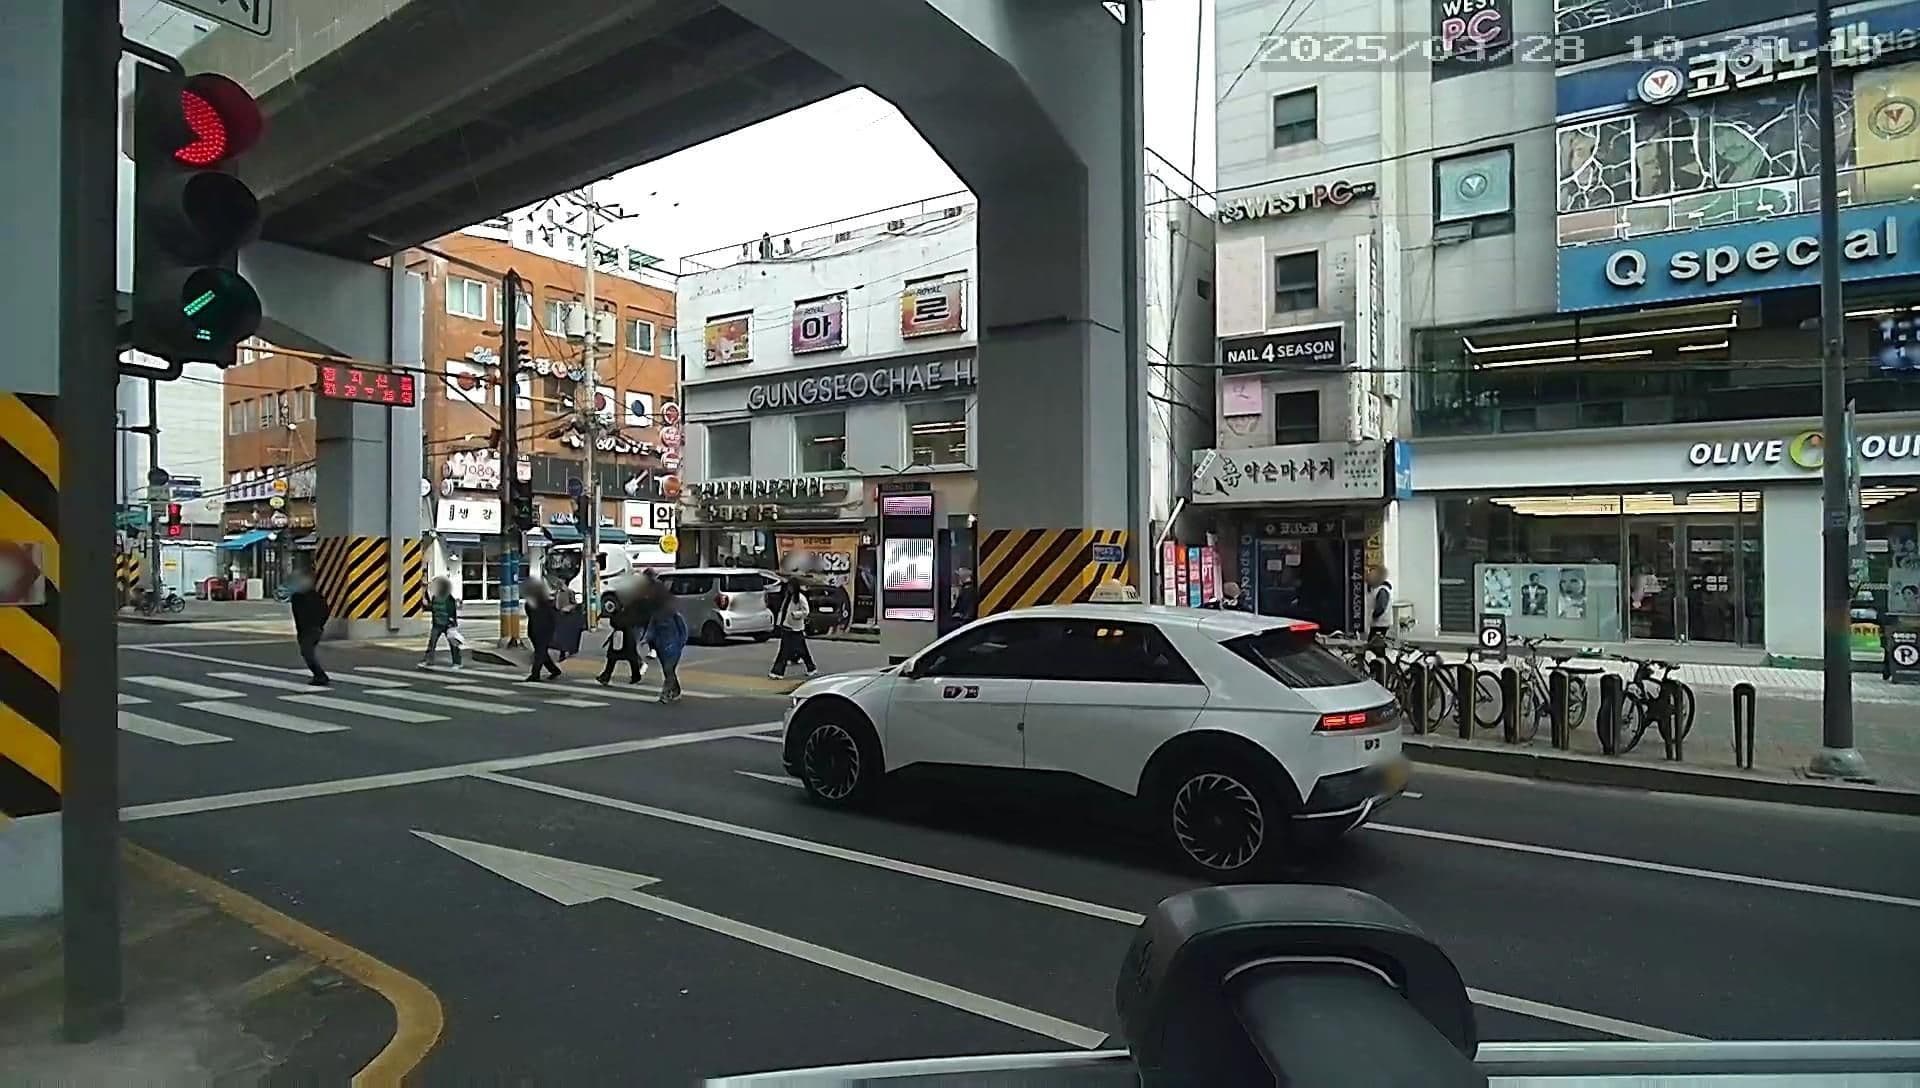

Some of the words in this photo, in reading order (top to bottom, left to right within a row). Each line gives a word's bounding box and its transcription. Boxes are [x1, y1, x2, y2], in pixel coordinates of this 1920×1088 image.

[1442, 9, 1502, 52] PC
[1312, 178, 1352, 209] PC
[1605, 249, 1647, 287] Q
[1669, 215, 1897, 283] specal
[916, 285, 943, 296] ROYAL
[1228, 348, 1259, 363] NAIL
[1262, 343, 1275, 362] 4
[1277, 340, 1335, 358] SEASON
[747, 362, 942, 410] GUNGSEOCHAE
[954, 359, 977, 387] H
[1689, 440, 1784, 465] OLIVE
[1244, 457, 1335, 484] 약손마사지
